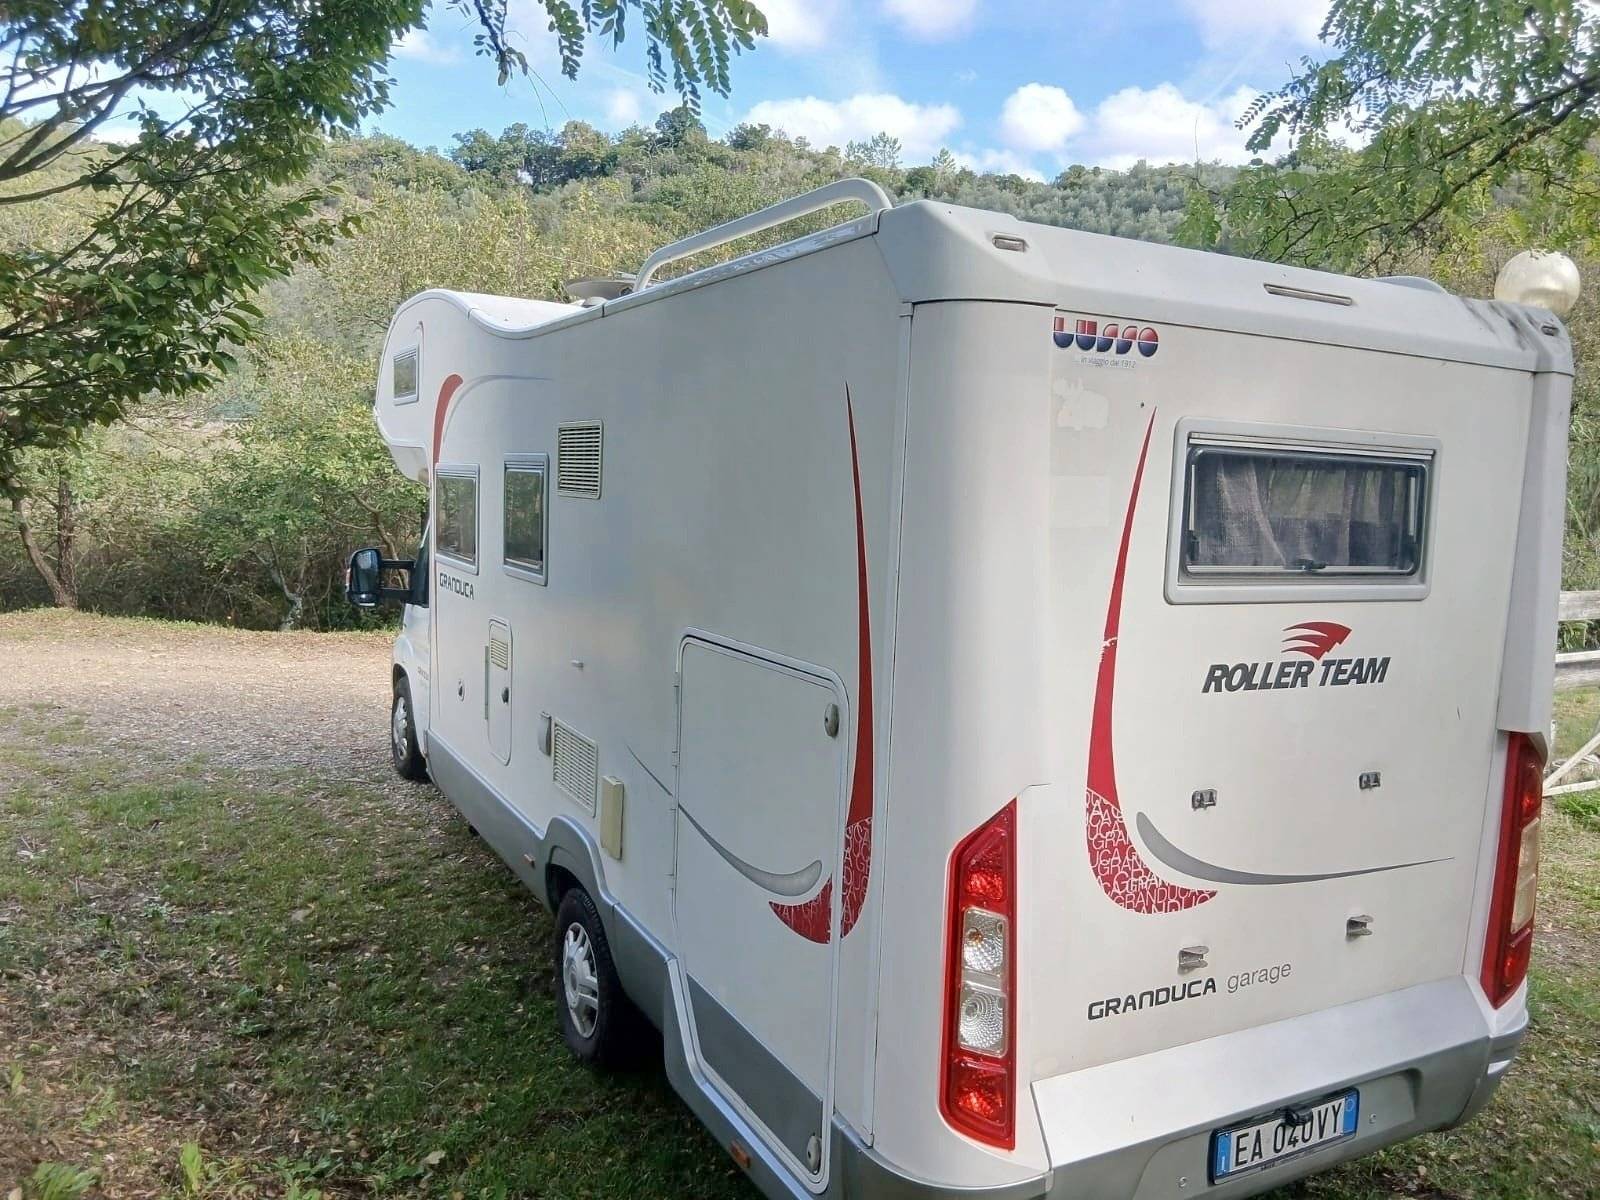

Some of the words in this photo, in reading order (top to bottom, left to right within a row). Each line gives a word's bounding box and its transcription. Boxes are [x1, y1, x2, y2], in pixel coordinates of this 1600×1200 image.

[439, 573, 474, 600] GRANDUCA
[1201, 660, 1315, 694] ROLLER
[1319, 656, 1392, 687] TEAM
[1087, 977, 1217, 1021] GRANDUCA
[1227, 963, 1292, 994] garage
[1235, 1130, 1263, 1167] EA
[1273, 1102, 1342, 1154] 040VY
